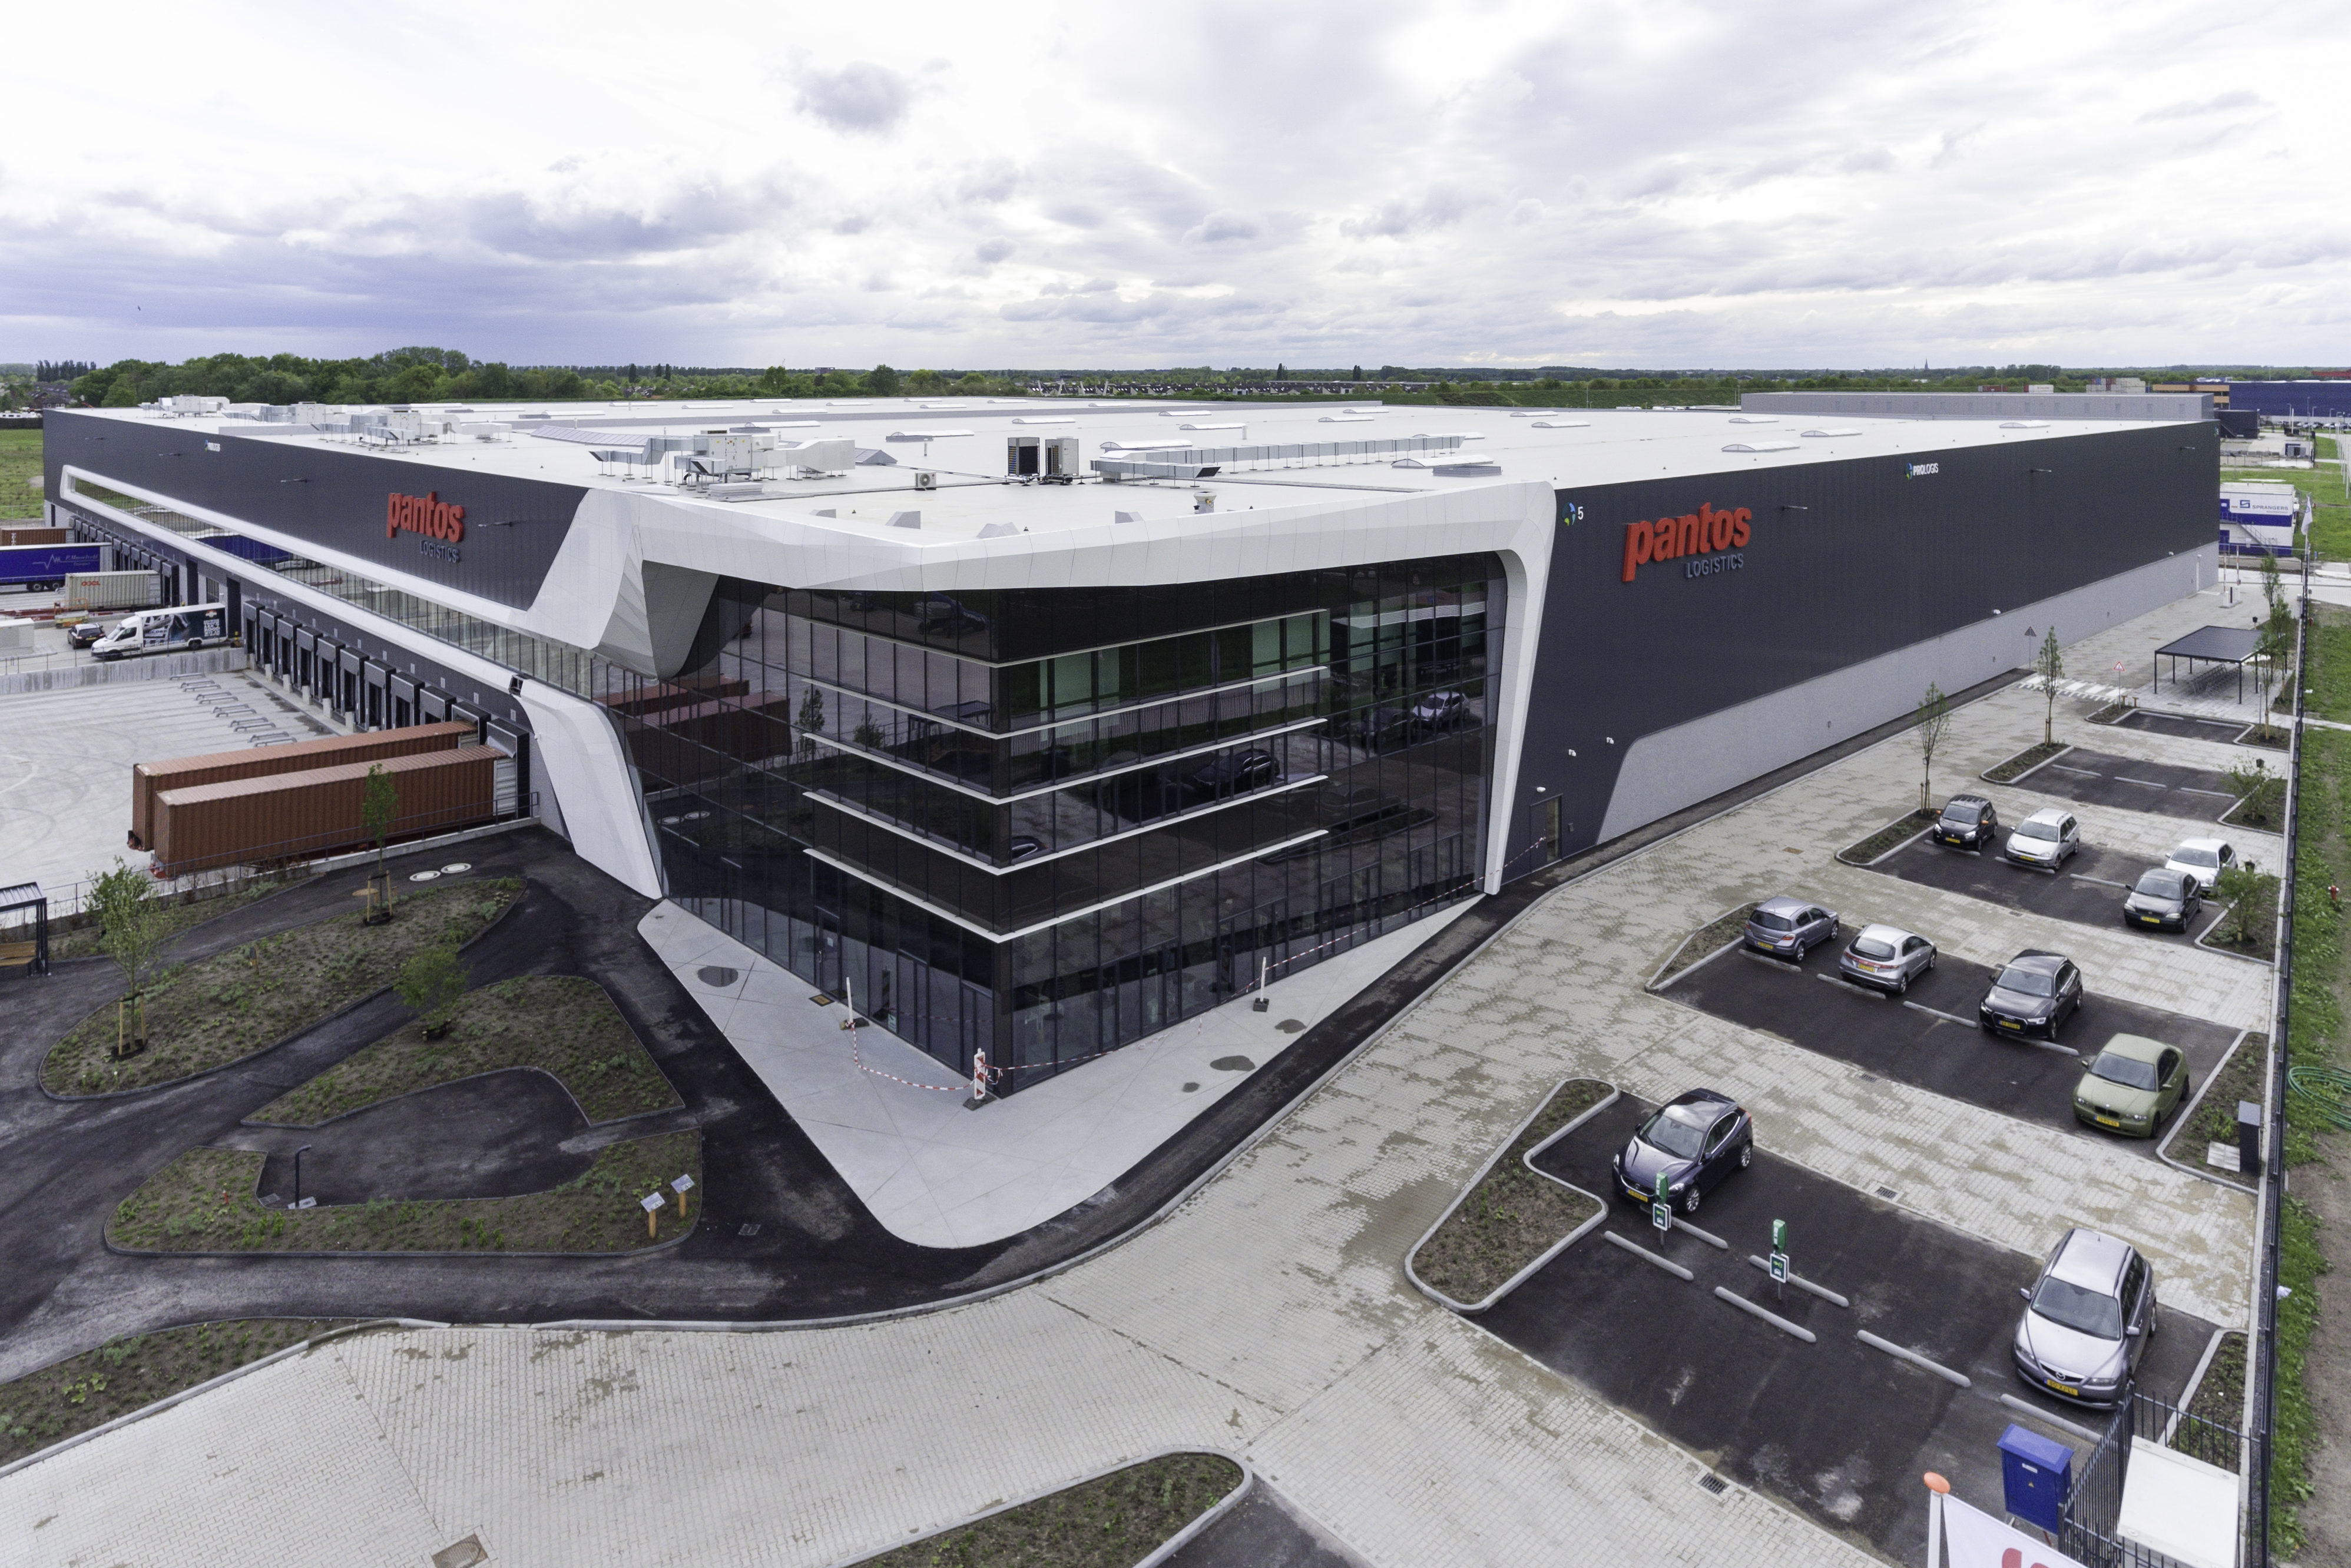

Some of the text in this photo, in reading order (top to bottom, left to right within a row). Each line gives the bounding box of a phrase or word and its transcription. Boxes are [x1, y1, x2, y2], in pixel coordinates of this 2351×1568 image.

[1913, 463, 1939, 476] PROLOGIS
[386, 491, 465, 543] pantos
[1577, 506, 1584, 520] 5
[420, 540, 459, 563] LOGISTICS
[1622, 502, 1752, 582] pantos
[1685, 553, 1744, 578] LOGISTICS
